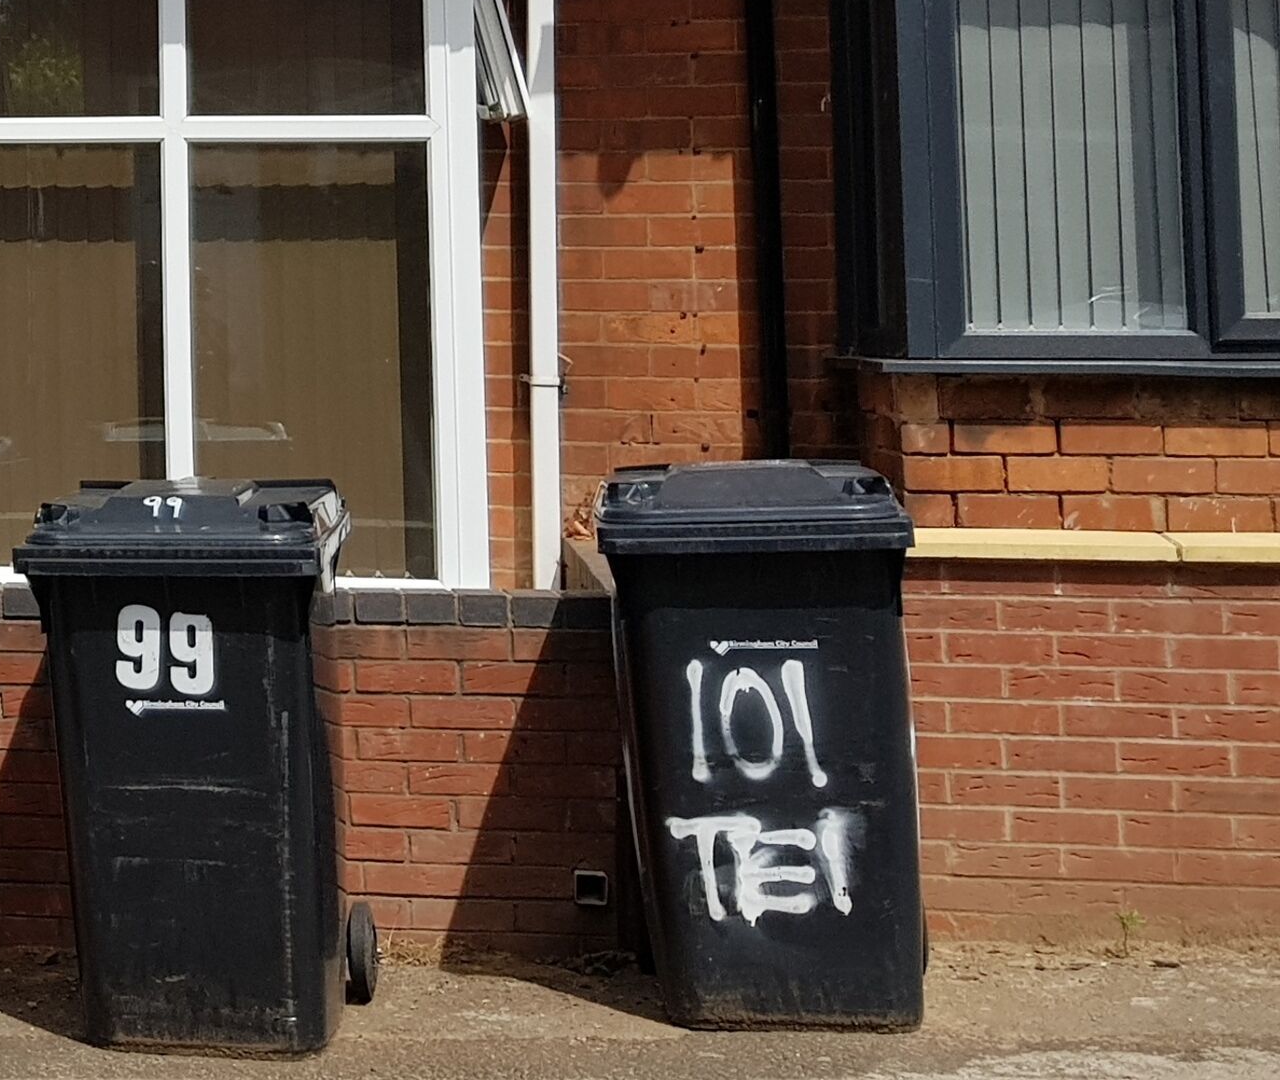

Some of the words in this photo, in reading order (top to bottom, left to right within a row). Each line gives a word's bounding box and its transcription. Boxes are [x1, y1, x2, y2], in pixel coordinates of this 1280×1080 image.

[142, 495, 183, 518] 99
[116, 604, 214, 695] 99
[775, 639, 790, 649] City
[686, 658, 827, 788] 101
